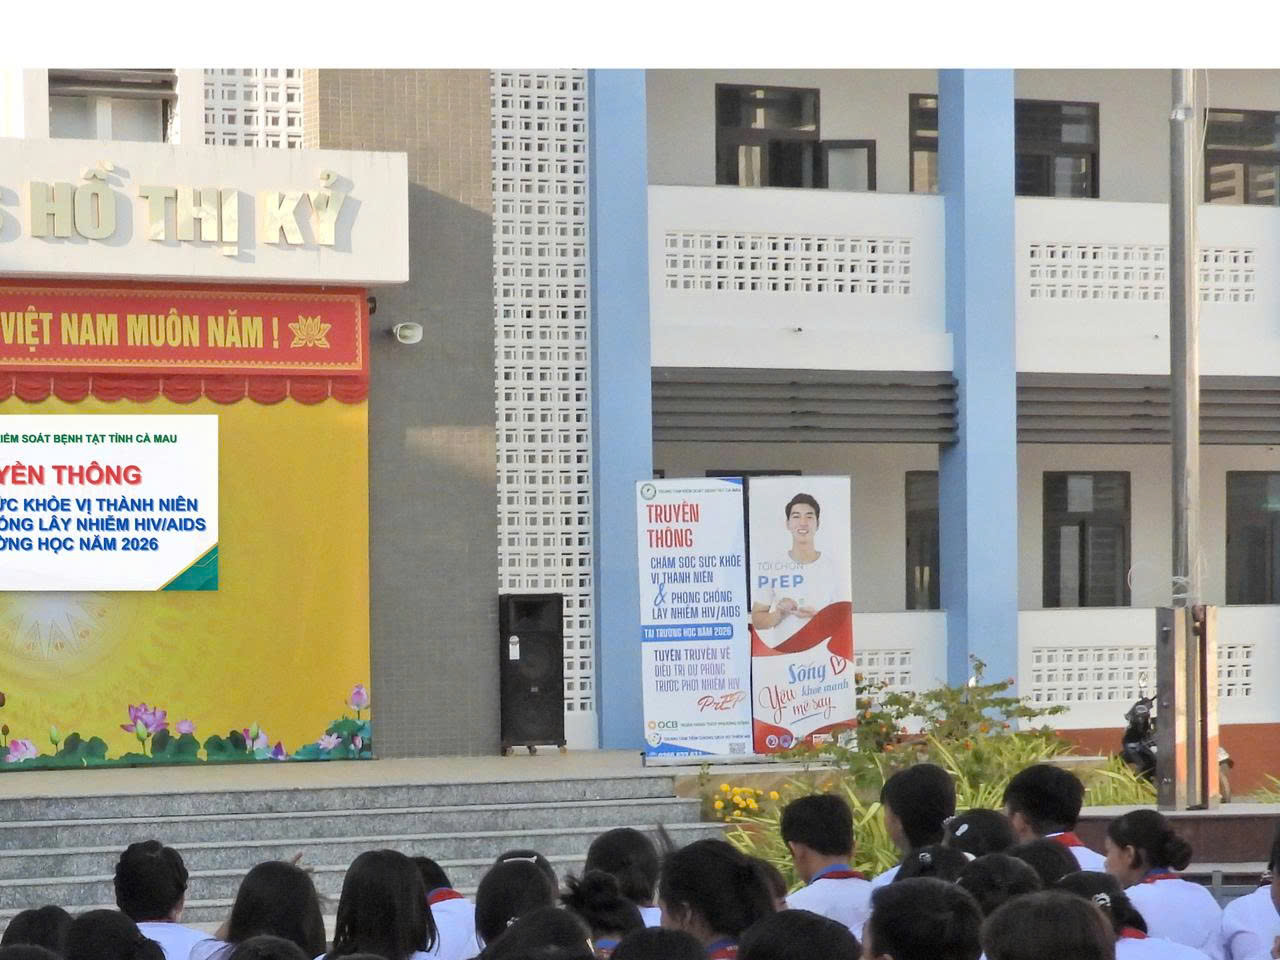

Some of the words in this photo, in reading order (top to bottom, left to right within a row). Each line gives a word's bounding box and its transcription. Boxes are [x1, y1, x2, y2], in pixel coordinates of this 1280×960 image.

[29, 160, 117, 240] HỒ
[137, 184, 239, 256] THỊ
[260, 169, 349, 246] KỶ
[0, 305, 53, 352] VIỆT
[61, 312, 119, 346] NAM
[126, 308, 200, 347] MUÔN
[207, 308, 264, 349] NĂM
[21, 432, 51, 443] SOÁT
[53, 433, 83, 445] BỆNH
[85, 433, 106, 445] TẬT
[108, 432, 133, 443] TỈNH
[135, 432, 151, 443] CÀ
[153, 434, 178, 443] MAU
[51, 460, 143, 485] THÔNG
[23, 495, 71, 512] KHỎE
[75, 498, 92, 515] VỊ
[96, 495, 154, 512] THÀNH
[158, 495, 199, 512] NIÊN
[38, 515, 72, 531] LÂY
[76, 515, 130, 531] NHIỄM
[134, 517, 207, 532] HIV/AIDS
[38, 537, 75, 554] HỌC
[79, 535, 117, 551] NĂM
[121, 537, 159, 551] 2026
[646, 526, 693, 548] THÔNG
[758, 575, 804, 588] PrEP
